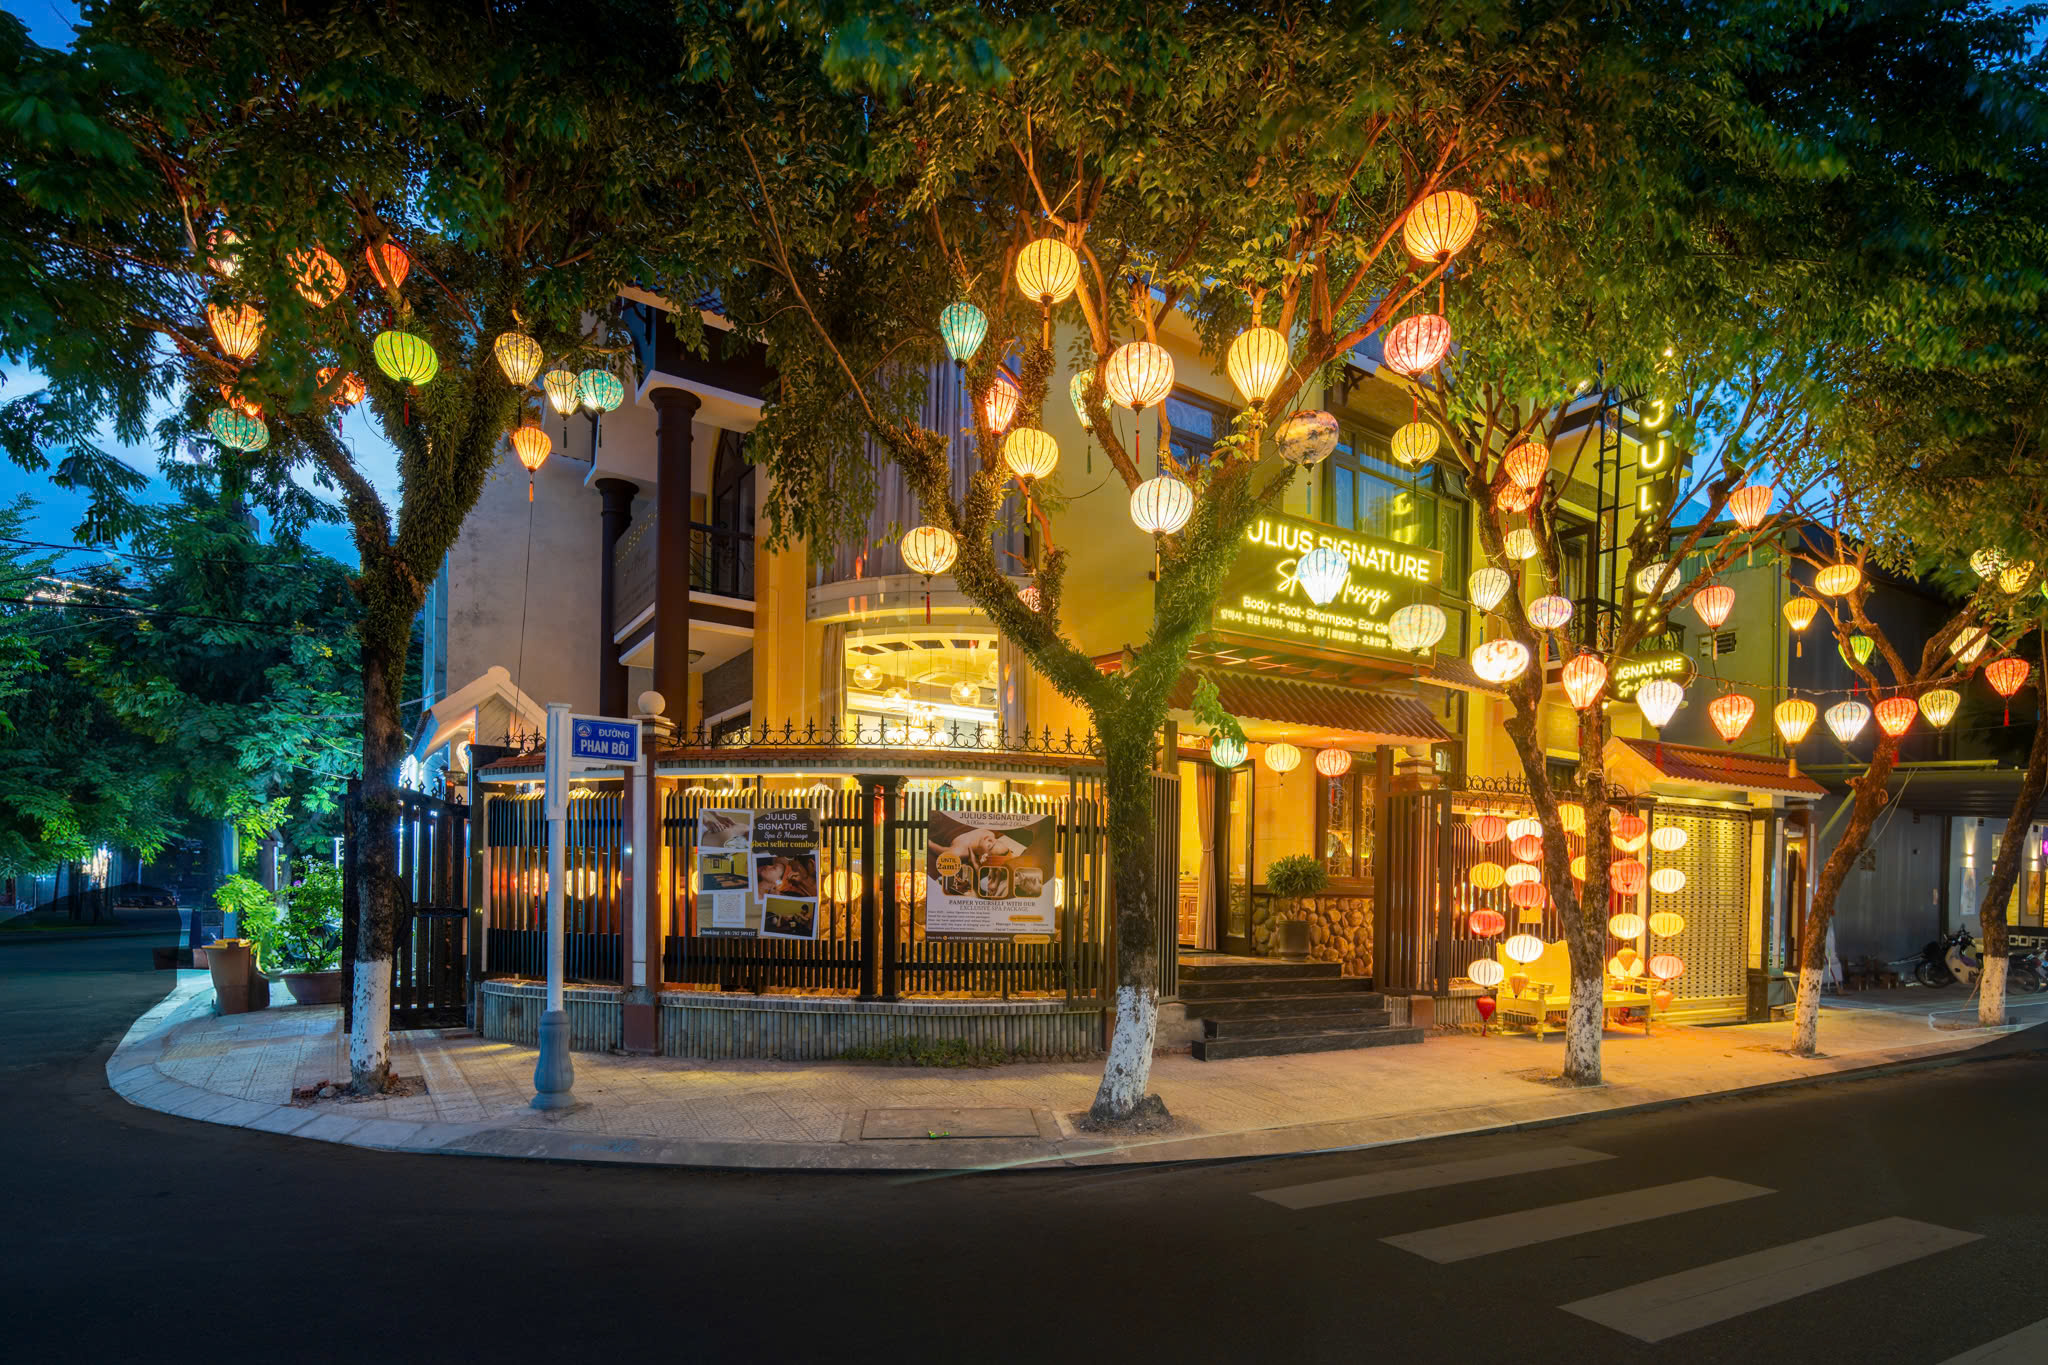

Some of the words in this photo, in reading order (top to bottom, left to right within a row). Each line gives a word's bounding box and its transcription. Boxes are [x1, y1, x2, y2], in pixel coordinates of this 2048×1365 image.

[1246, 518, 1314, 554] ULIUS
[1243, 595, 1271, 614] Body
[1358, 617, 1374, 631] Ear
[598, 727, 631, 739] ĐƯỜNG
[580, 739, 609, 754] PHAN
[611, 740, 629, 756] BÔI
[765, 813, 798, 821] JULIUS
[959, 812, 987, 820] JULIUS
[988, 813, 1031, 822] SIGNATURE
[757, 822, 808, 831] SIGNATURE
